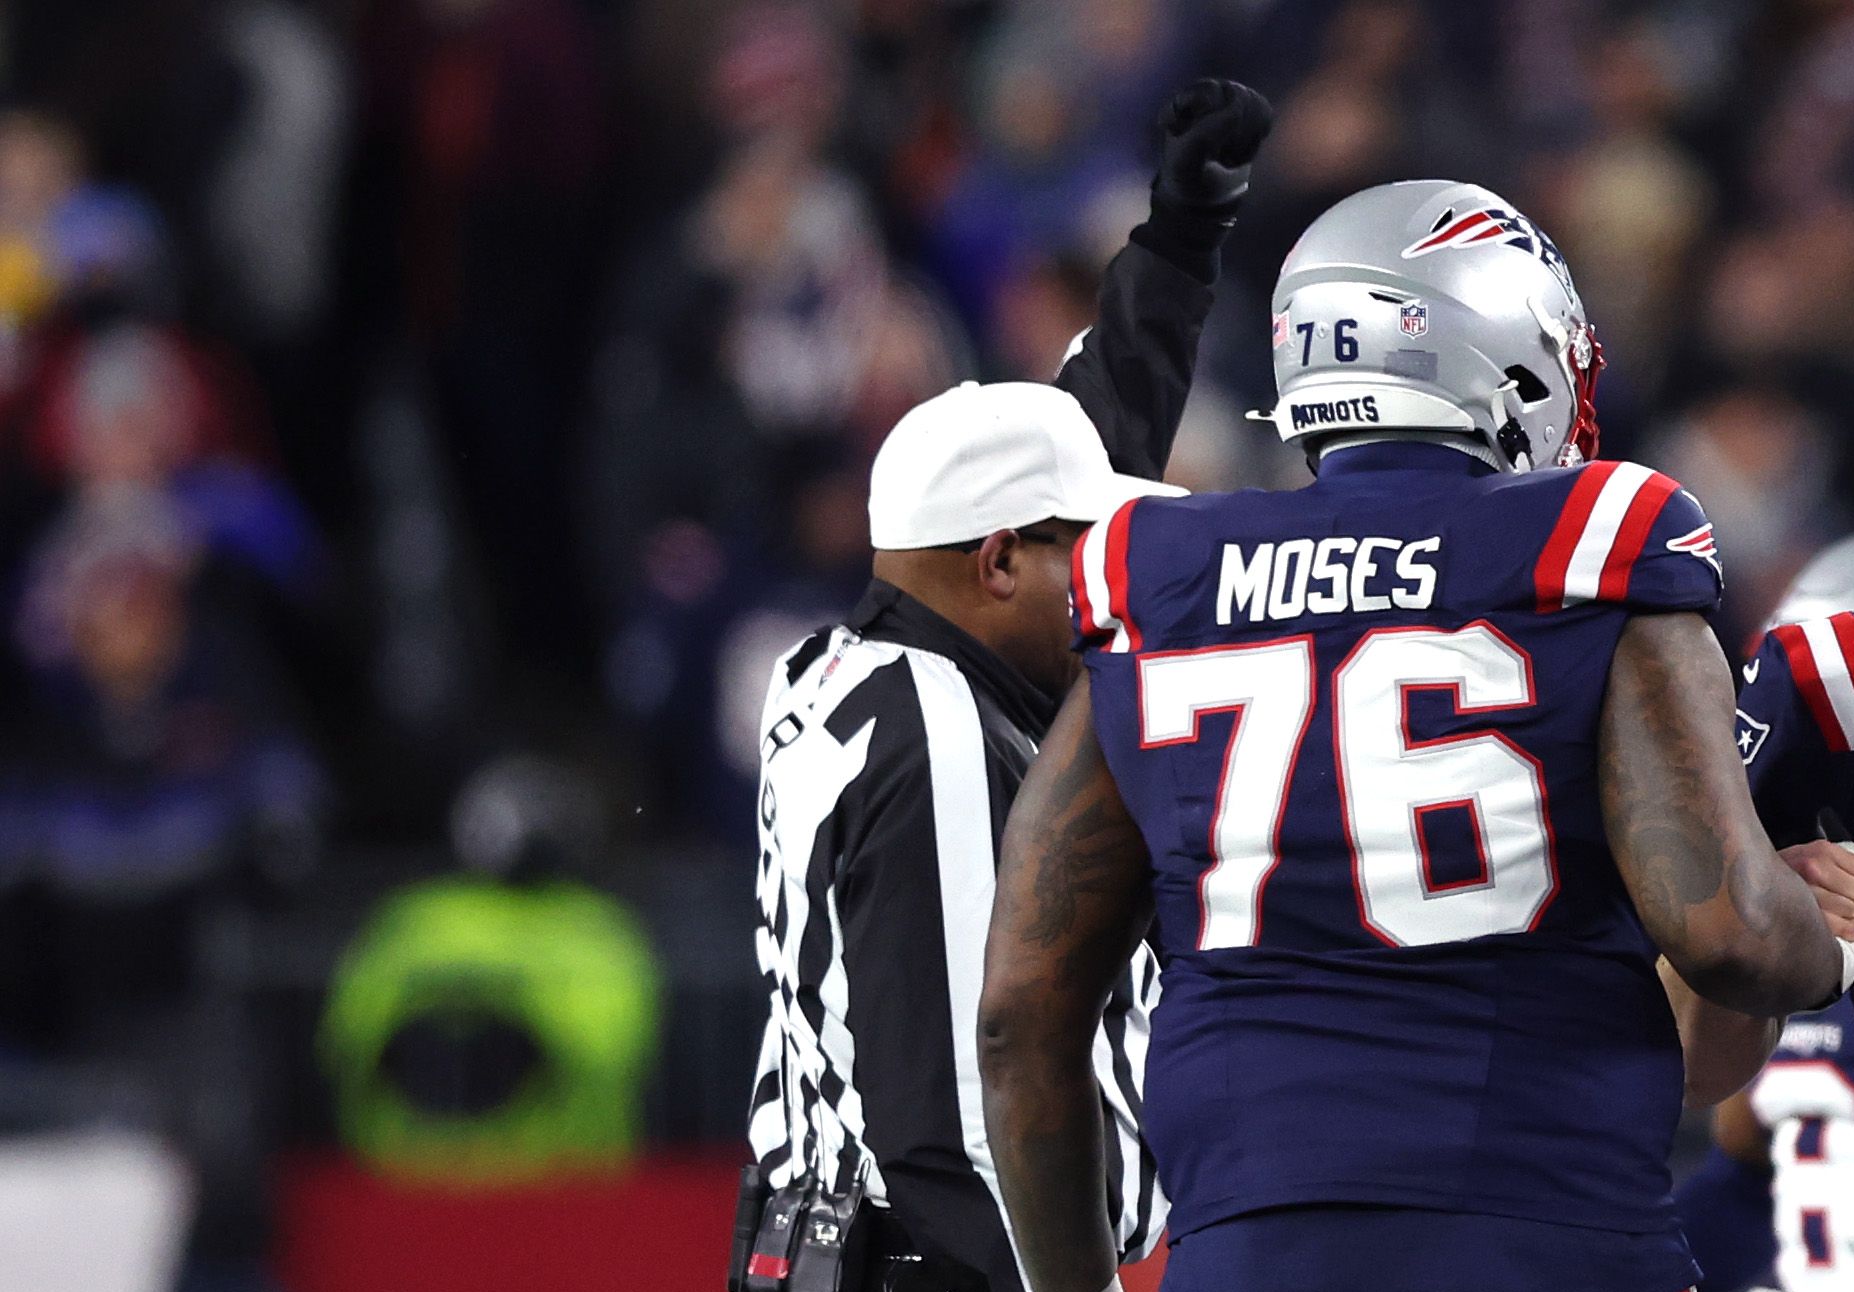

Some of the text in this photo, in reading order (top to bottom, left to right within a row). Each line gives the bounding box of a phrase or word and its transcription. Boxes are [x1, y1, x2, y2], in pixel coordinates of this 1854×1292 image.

[1296, 318, 1359, 367] 76
[1290, 395, 1380, 431] PATRIOTS
[1215, 536, 1441, 626] MOSES
[1136, 618, 1561, 951] 76
